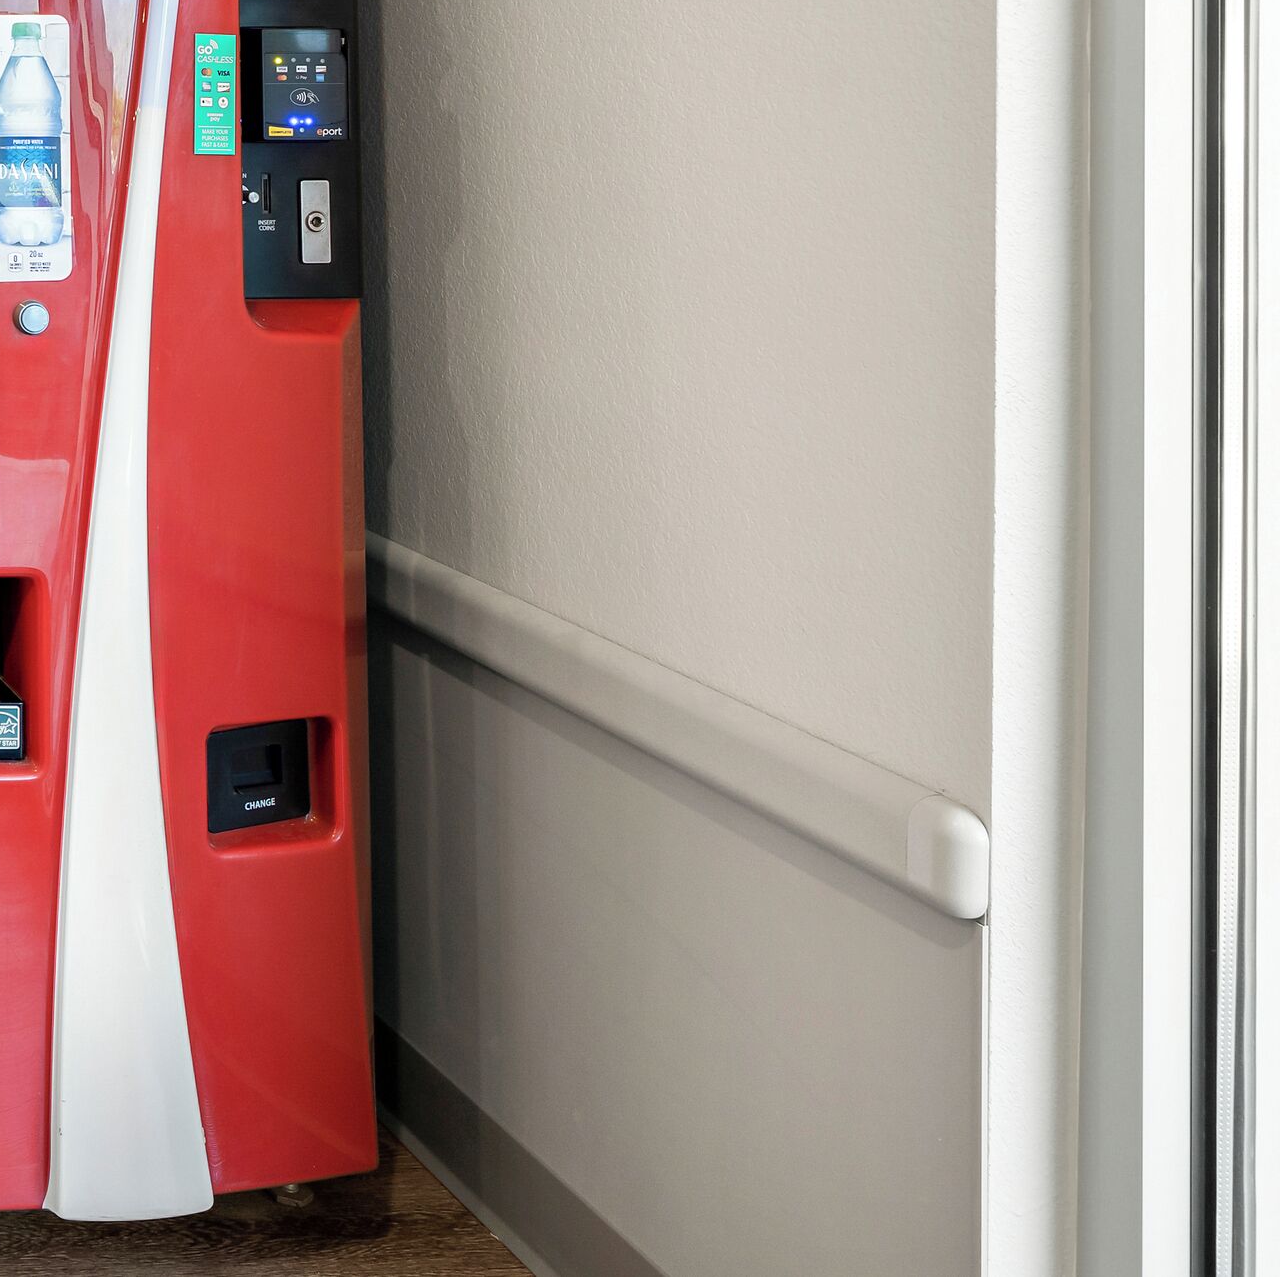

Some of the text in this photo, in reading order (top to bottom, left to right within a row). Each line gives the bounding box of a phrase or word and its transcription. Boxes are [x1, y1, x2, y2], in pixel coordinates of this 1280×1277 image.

[197, 45, 213, 55] GO
[197, 55, 234, 64] CASHLESS
[316, 127, 343, 137] eport
[0, 159, 58, 182] DASANI
[244, 797, 276, 810] CHANGE
